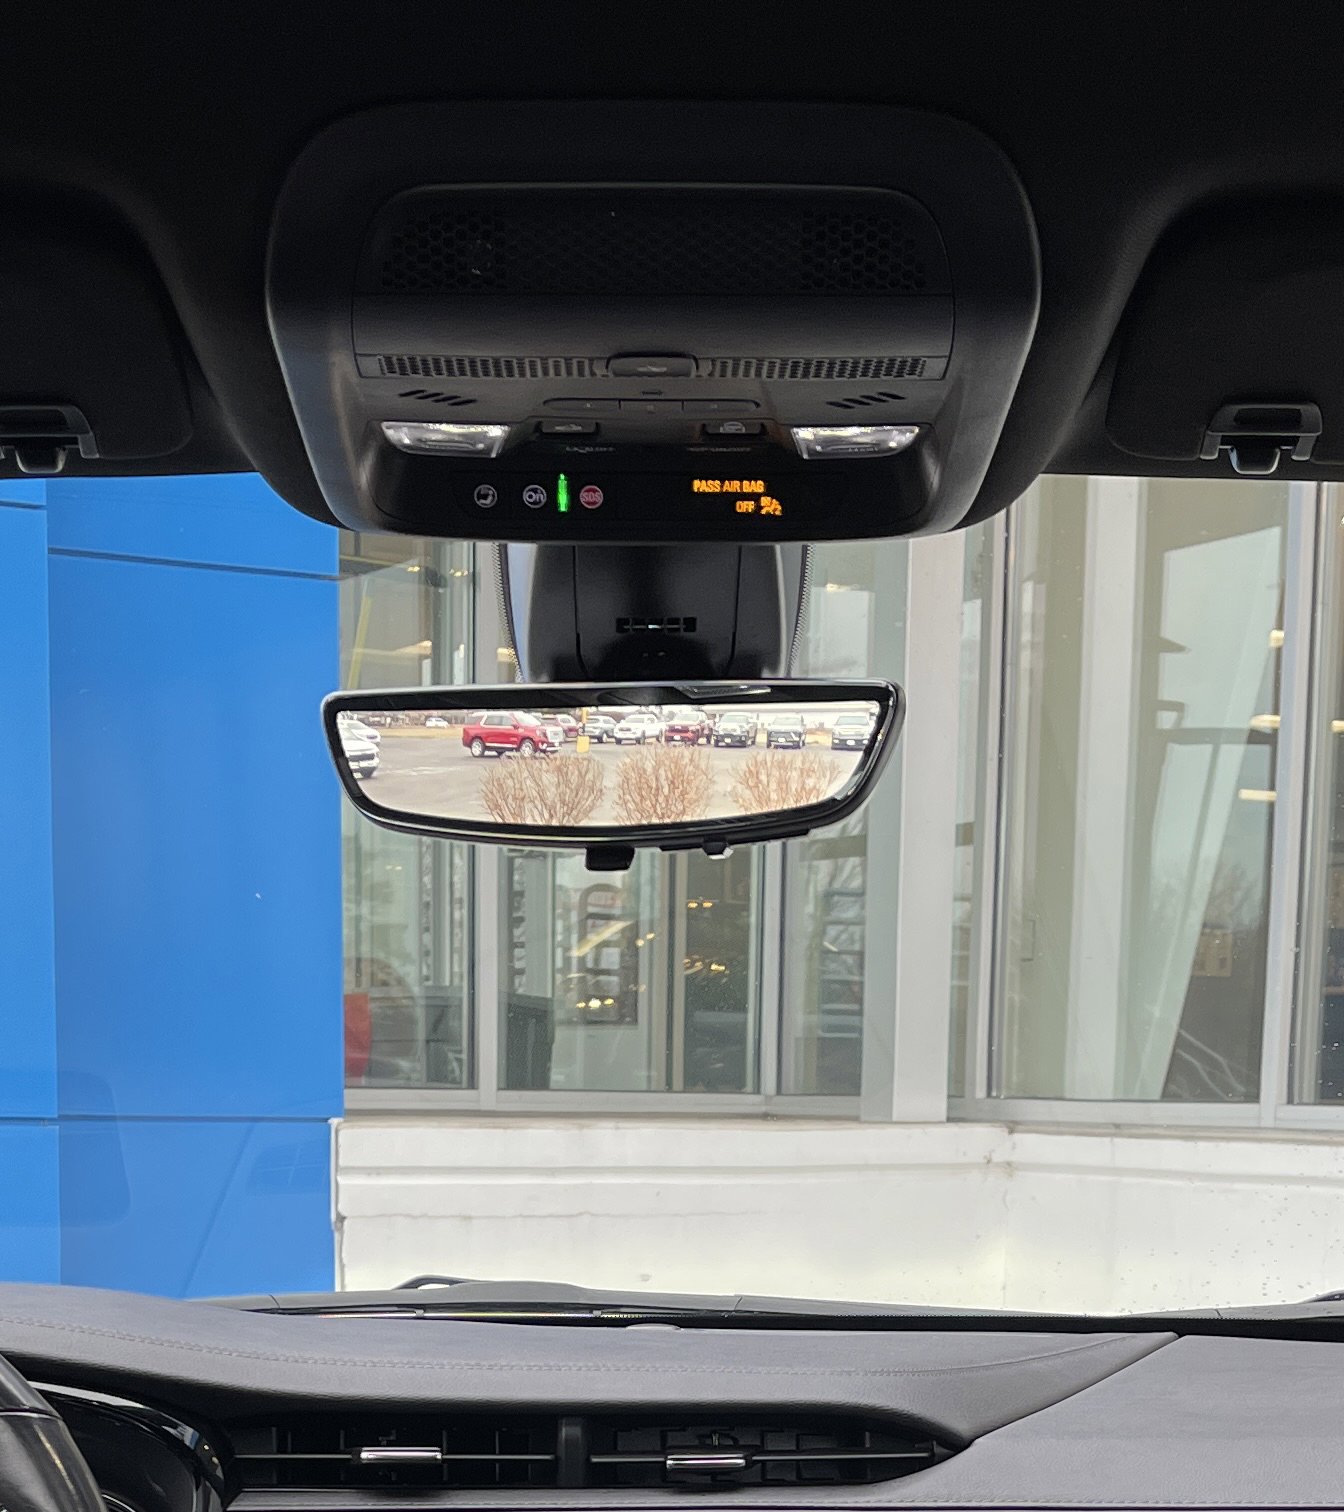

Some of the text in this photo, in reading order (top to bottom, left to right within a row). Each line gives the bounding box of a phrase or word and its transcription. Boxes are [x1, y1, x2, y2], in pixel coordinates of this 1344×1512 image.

[693, 479, 765, 493] PASS AIR BAG
[581, 491, 602, 502] SOS
[736, 500, 755, 513] OFF
